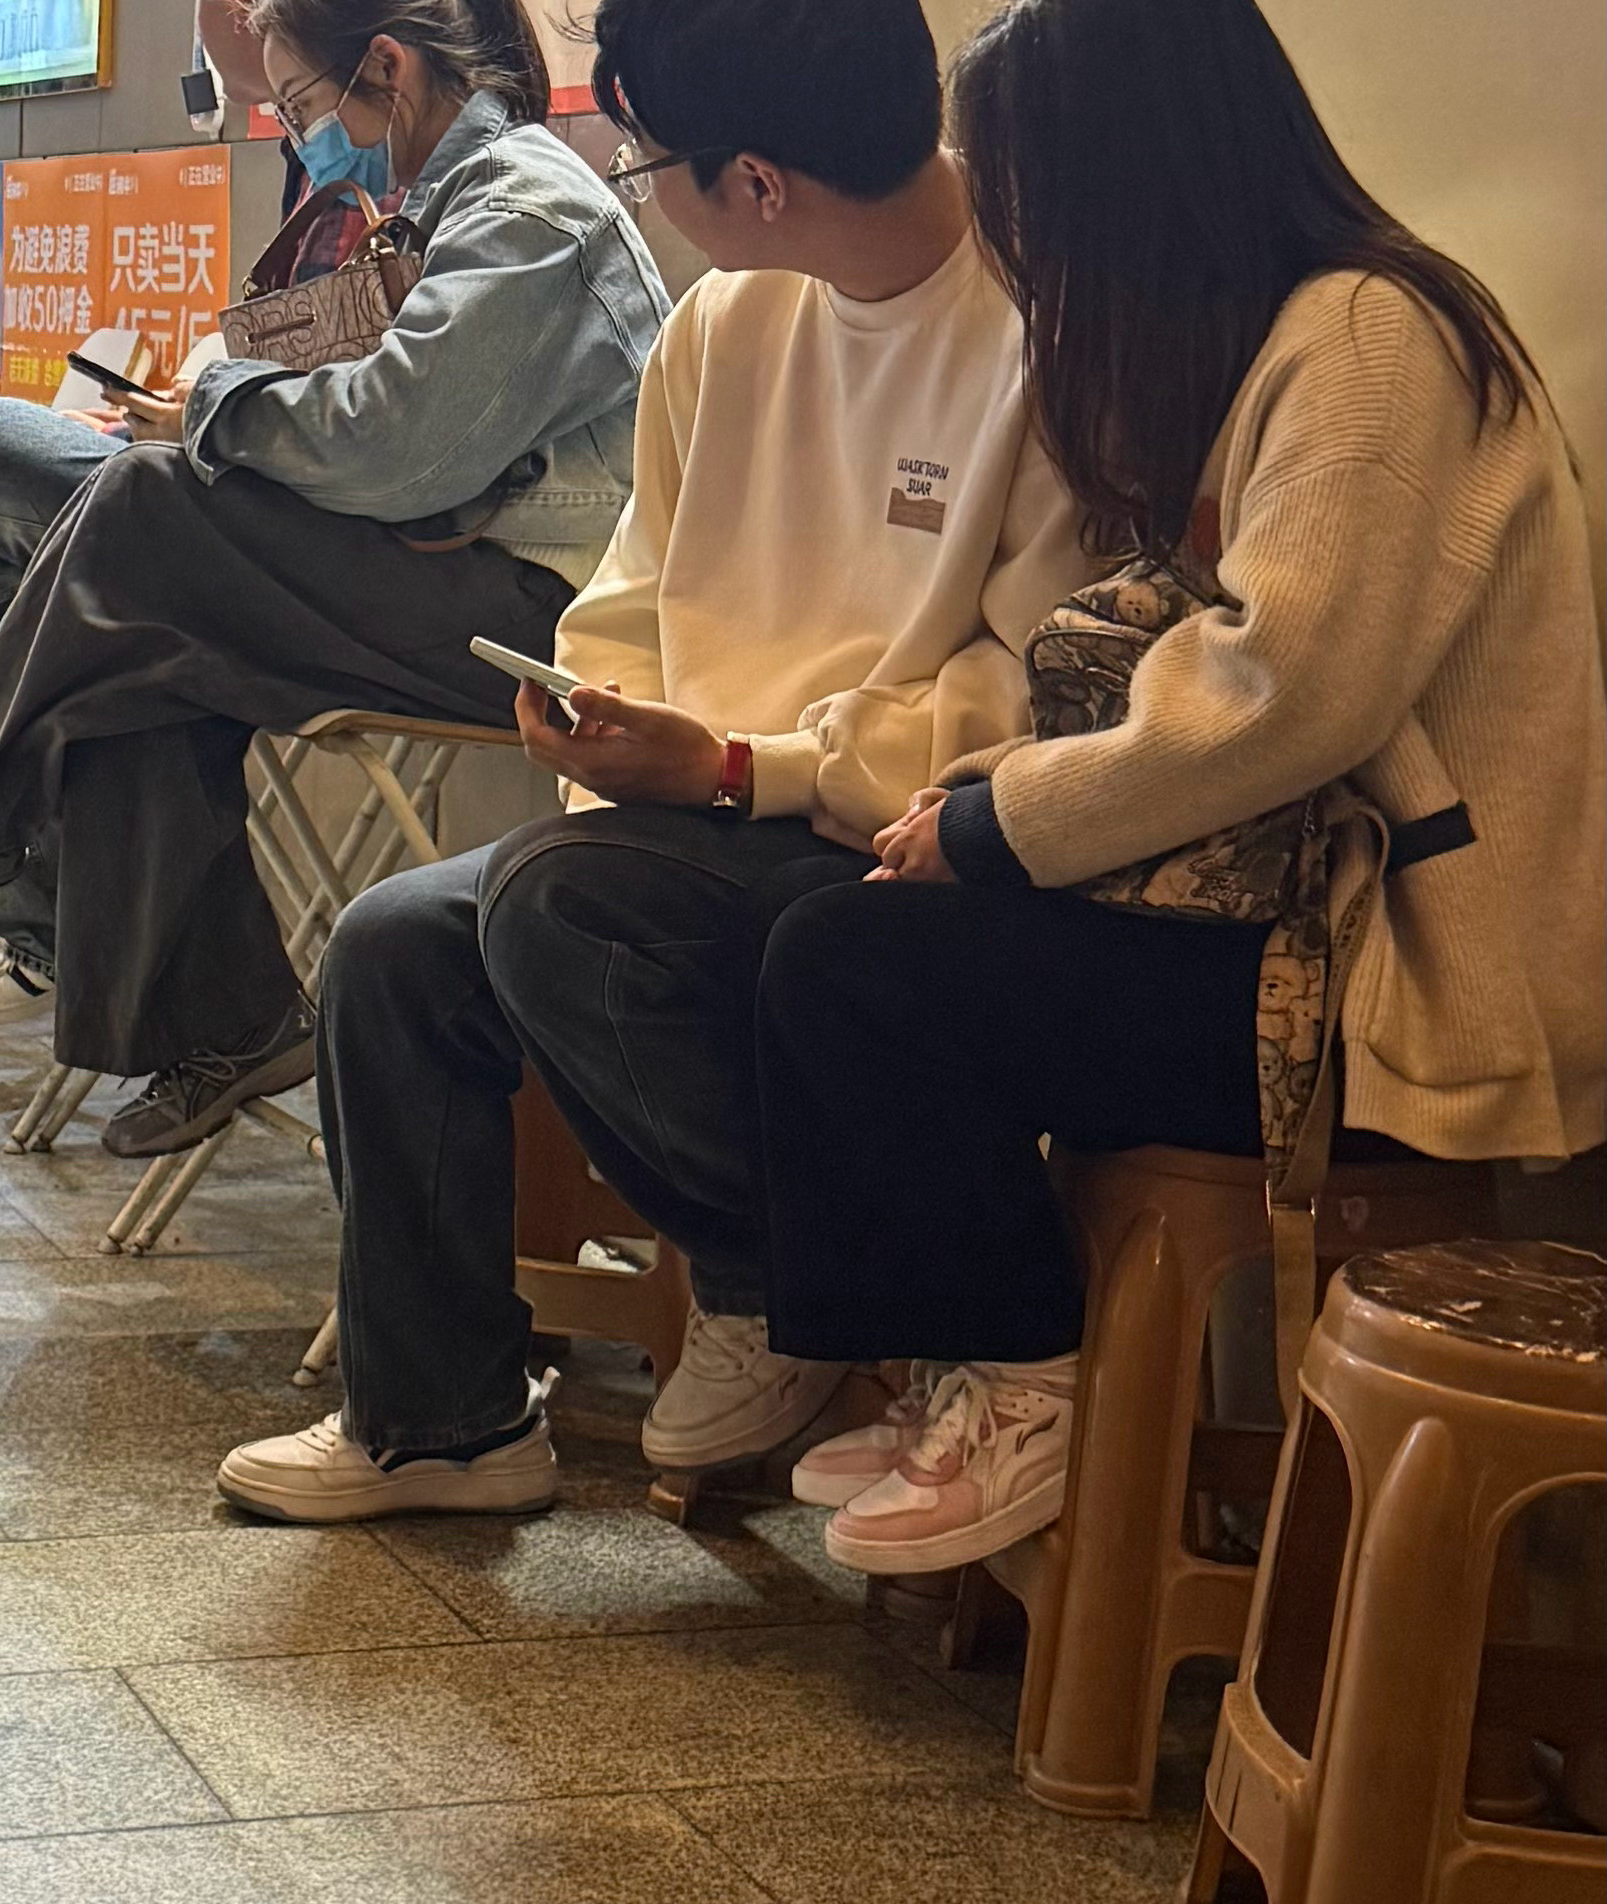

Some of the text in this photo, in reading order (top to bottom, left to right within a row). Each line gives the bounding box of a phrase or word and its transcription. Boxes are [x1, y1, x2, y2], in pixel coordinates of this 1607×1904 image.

[10, 224, 91, 274] 为避免浪费
[110, 221, 216, 295] 只卖当天
[3, 284, 94, 334] 加收50押金
